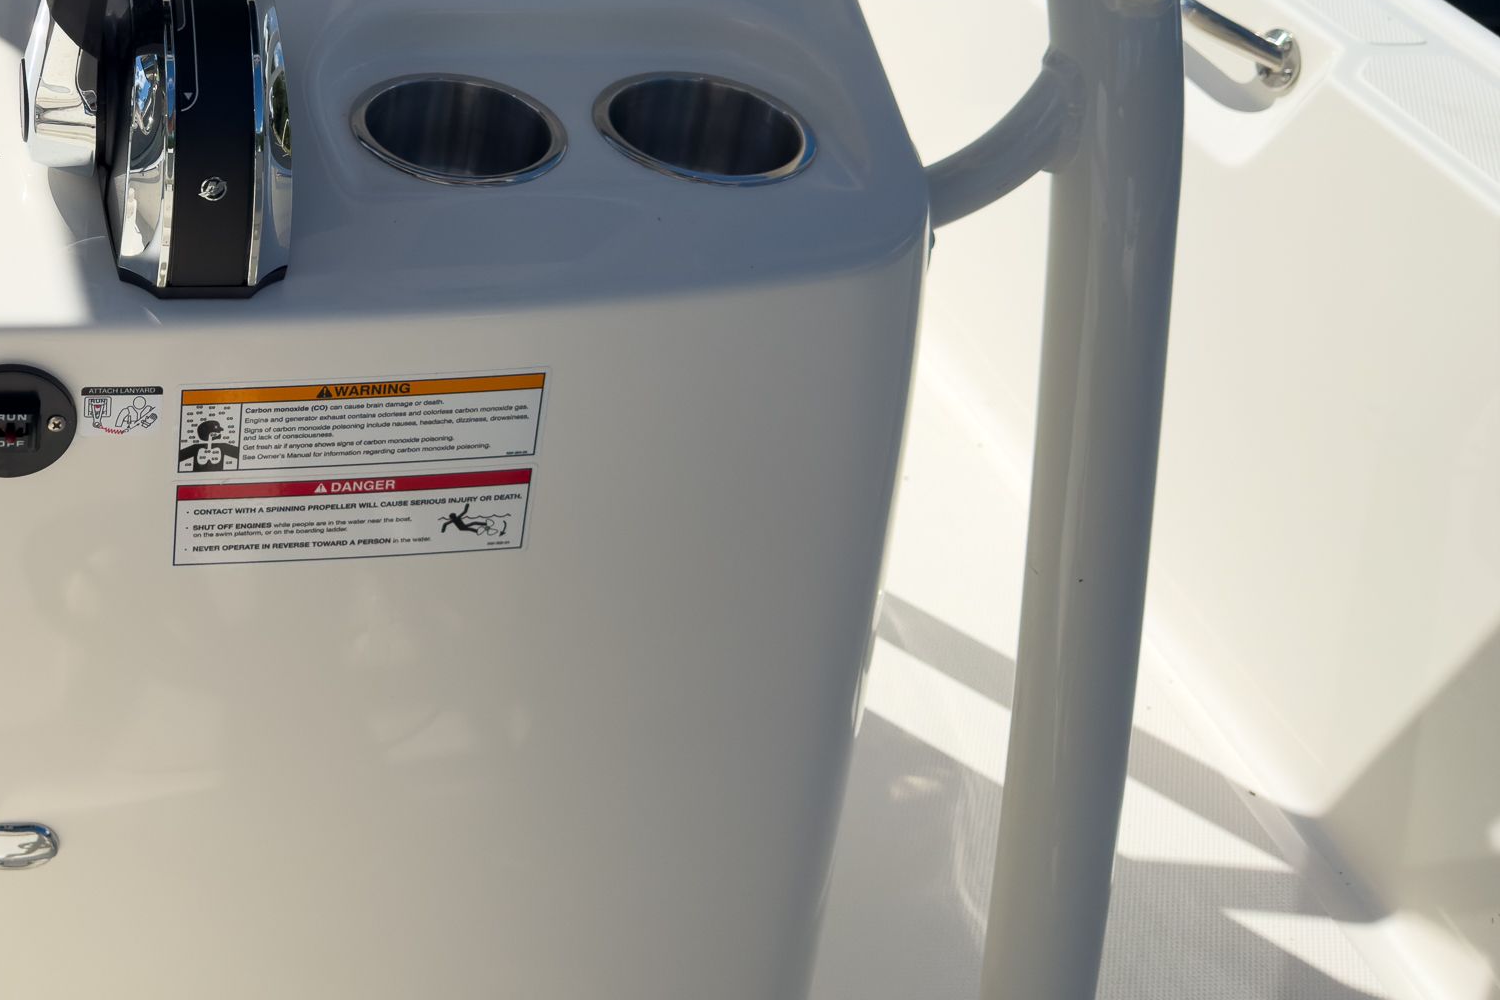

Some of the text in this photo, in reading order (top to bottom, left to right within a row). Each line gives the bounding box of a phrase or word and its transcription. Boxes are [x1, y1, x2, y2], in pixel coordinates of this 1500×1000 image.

[88, 386, 156, 395] ATTACH LANYARD
[333, 382, 411, 397] WARNING
[244, 406, 272, 414] Carbon
[272, 405, 310, 413] monoxide
[310, 404, 328, 412] (CO)
[330, 479, 395, 492] DANGER
[192, 507, 233, 516] CONTACT
[265, 504, 306, 513] SPINNING
[307, 502, 357, 511] PROPELLER
[379, 499, 408, 508] CAUSE
[409, 497, 447, 506] SERIOUS
[447, 496, 478, 505] INJURY
[493, 492, 523, 500] DEATH.
